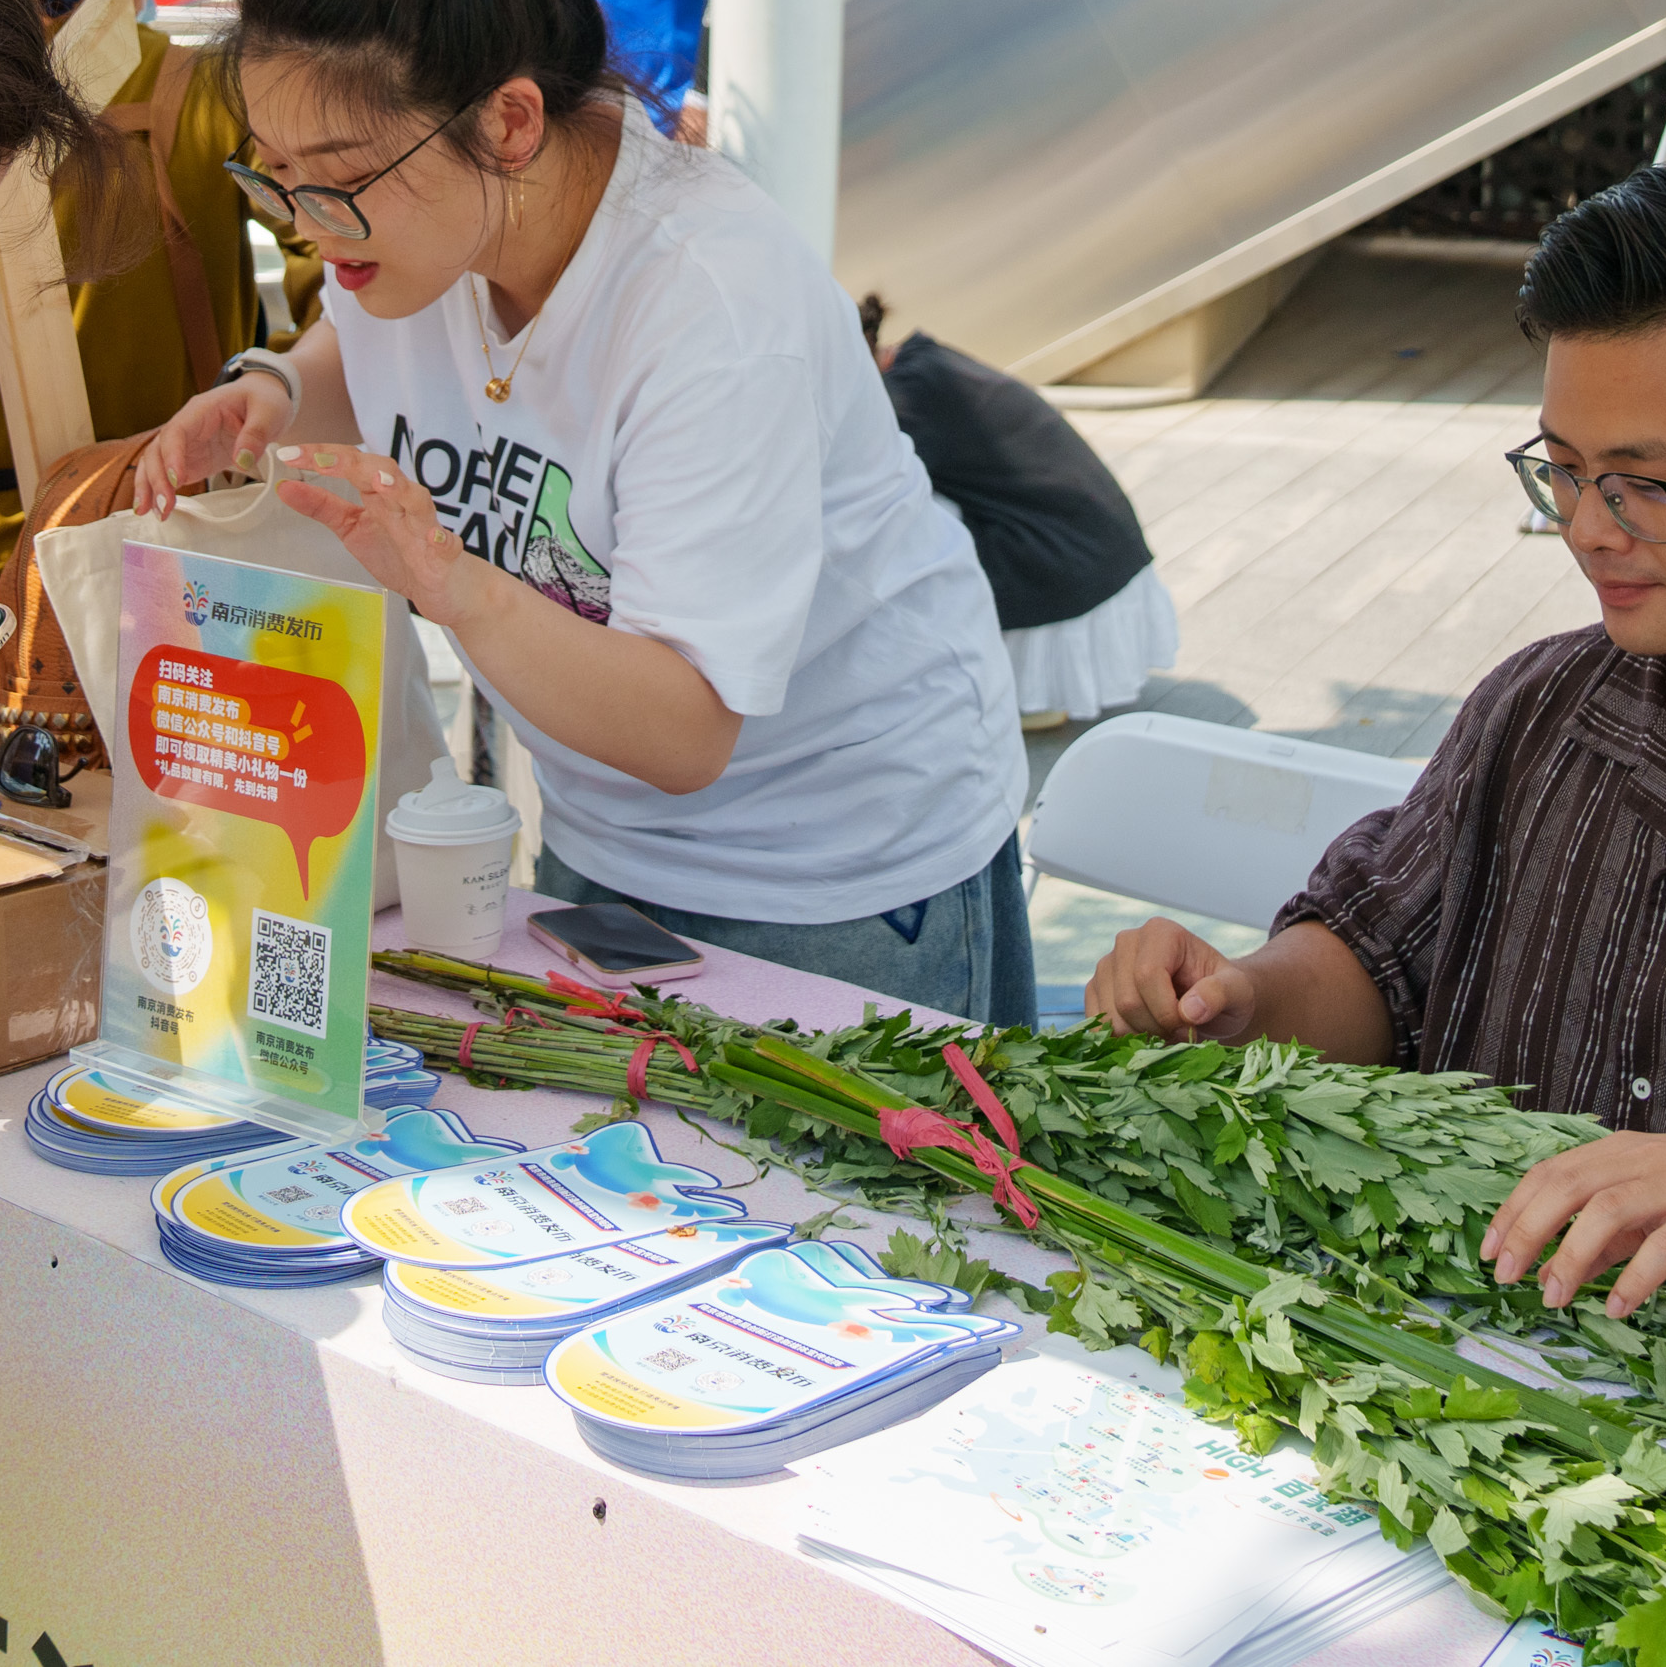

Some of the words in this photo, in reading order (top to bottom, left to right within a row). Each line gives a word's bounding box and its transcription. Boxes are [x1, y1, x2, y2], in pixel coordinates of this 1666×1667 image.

[211, 601, 323, 641] 南京消费发布
[158, 659, 214, 689] 扫码关注
[157, 684, 241, 720] 南京消费发布
[156, 710, 281, 757] 微信公众号和抖音号
[155, 735, 308, 789] 即可领取精美小礼物一份
[137, 995, 194, 1024] 南京消费发布
[150, 1016, 179, 1036] 抖音号
[256, 1030, 315, 1060] 南京消费发布
[259, 1049, 310, 1076] 微信公众号
[1273, 1478, 1372, 1528] 百家湖
